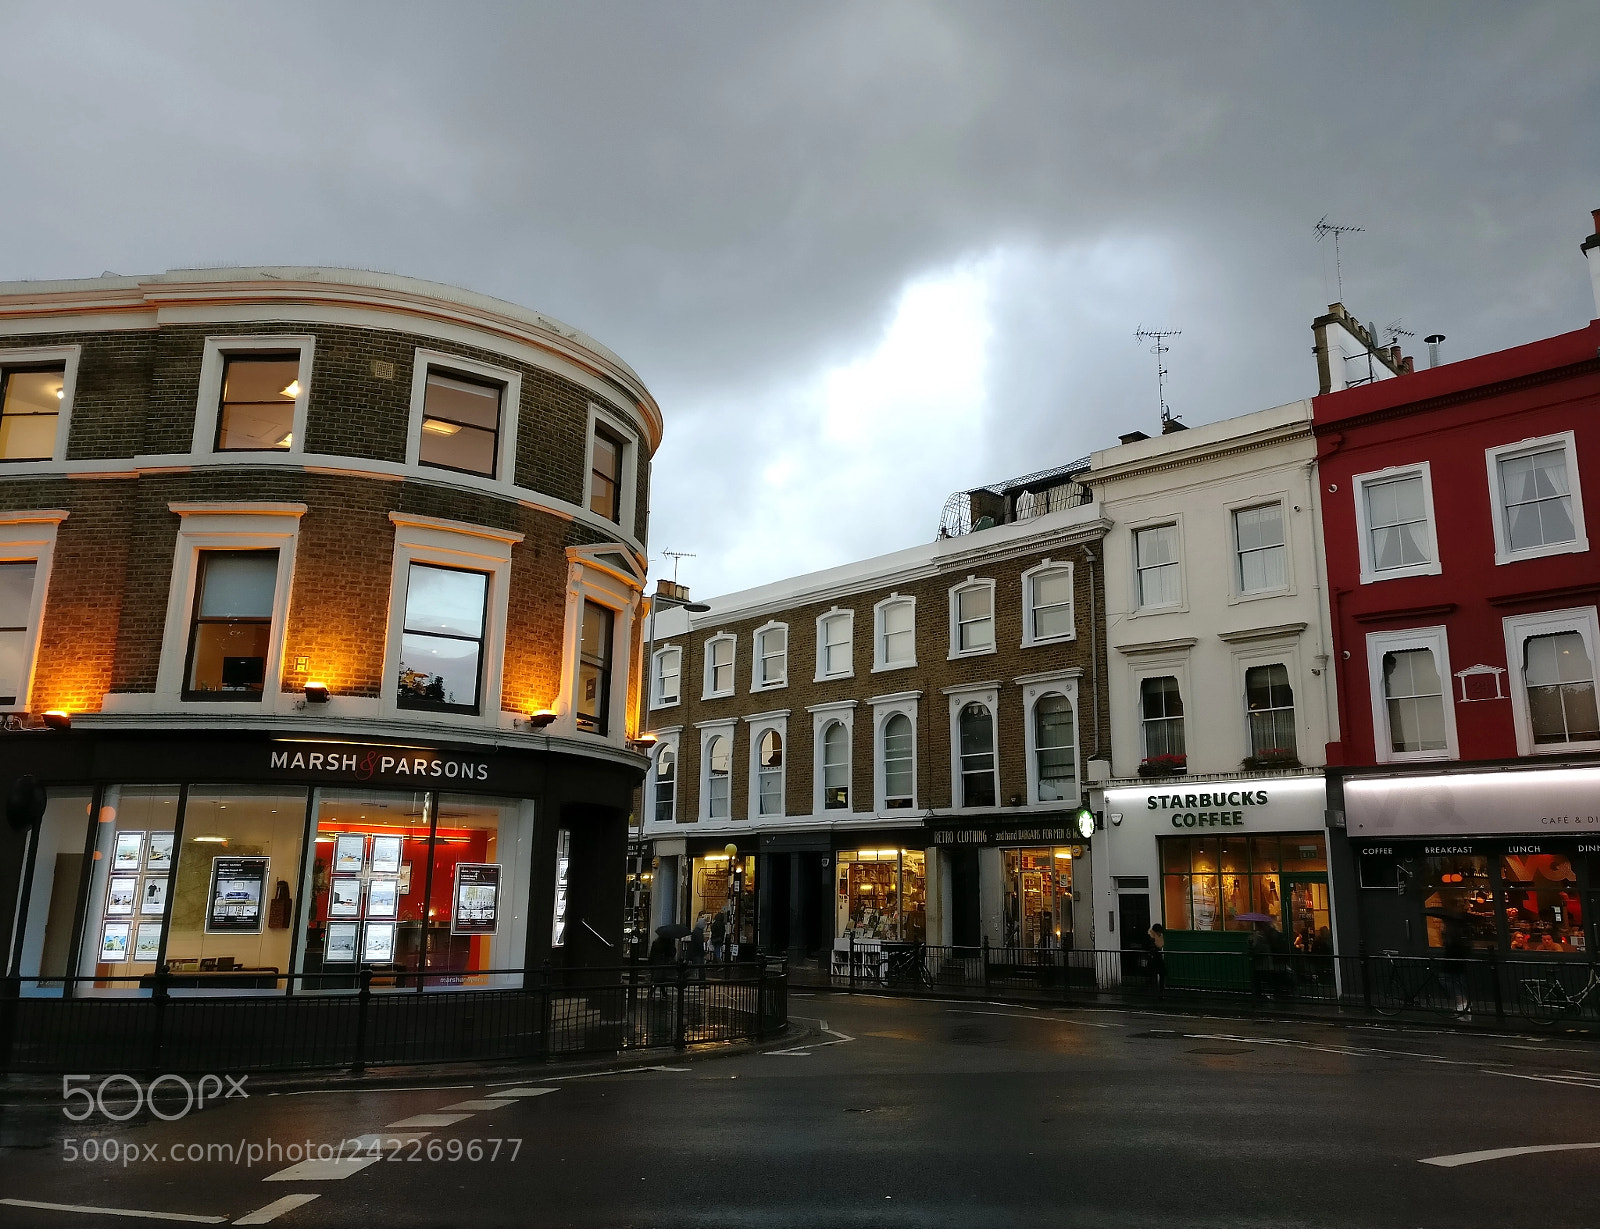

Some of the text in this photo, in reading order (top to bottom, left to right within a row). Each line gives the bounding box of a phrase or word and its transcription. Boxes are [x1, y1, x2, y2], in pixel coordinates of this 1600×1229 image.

[270, 751, 357, 771] MARSH
[380, 756, 489, 780] PARSONS
[1147, 791, 1268, 810] STARBUCKS
[1171, 811, 1244, 828] COFFEE
[1541, 815, 1569, 824] CAFÉ
[1574, 816, 1582, 824] &
[934, 830, 988, 844] RETRO CLOTHING
[1424, 846, 1473, 854] BREAKFAST
[1508, 845, 1541, 853] LUNCH
